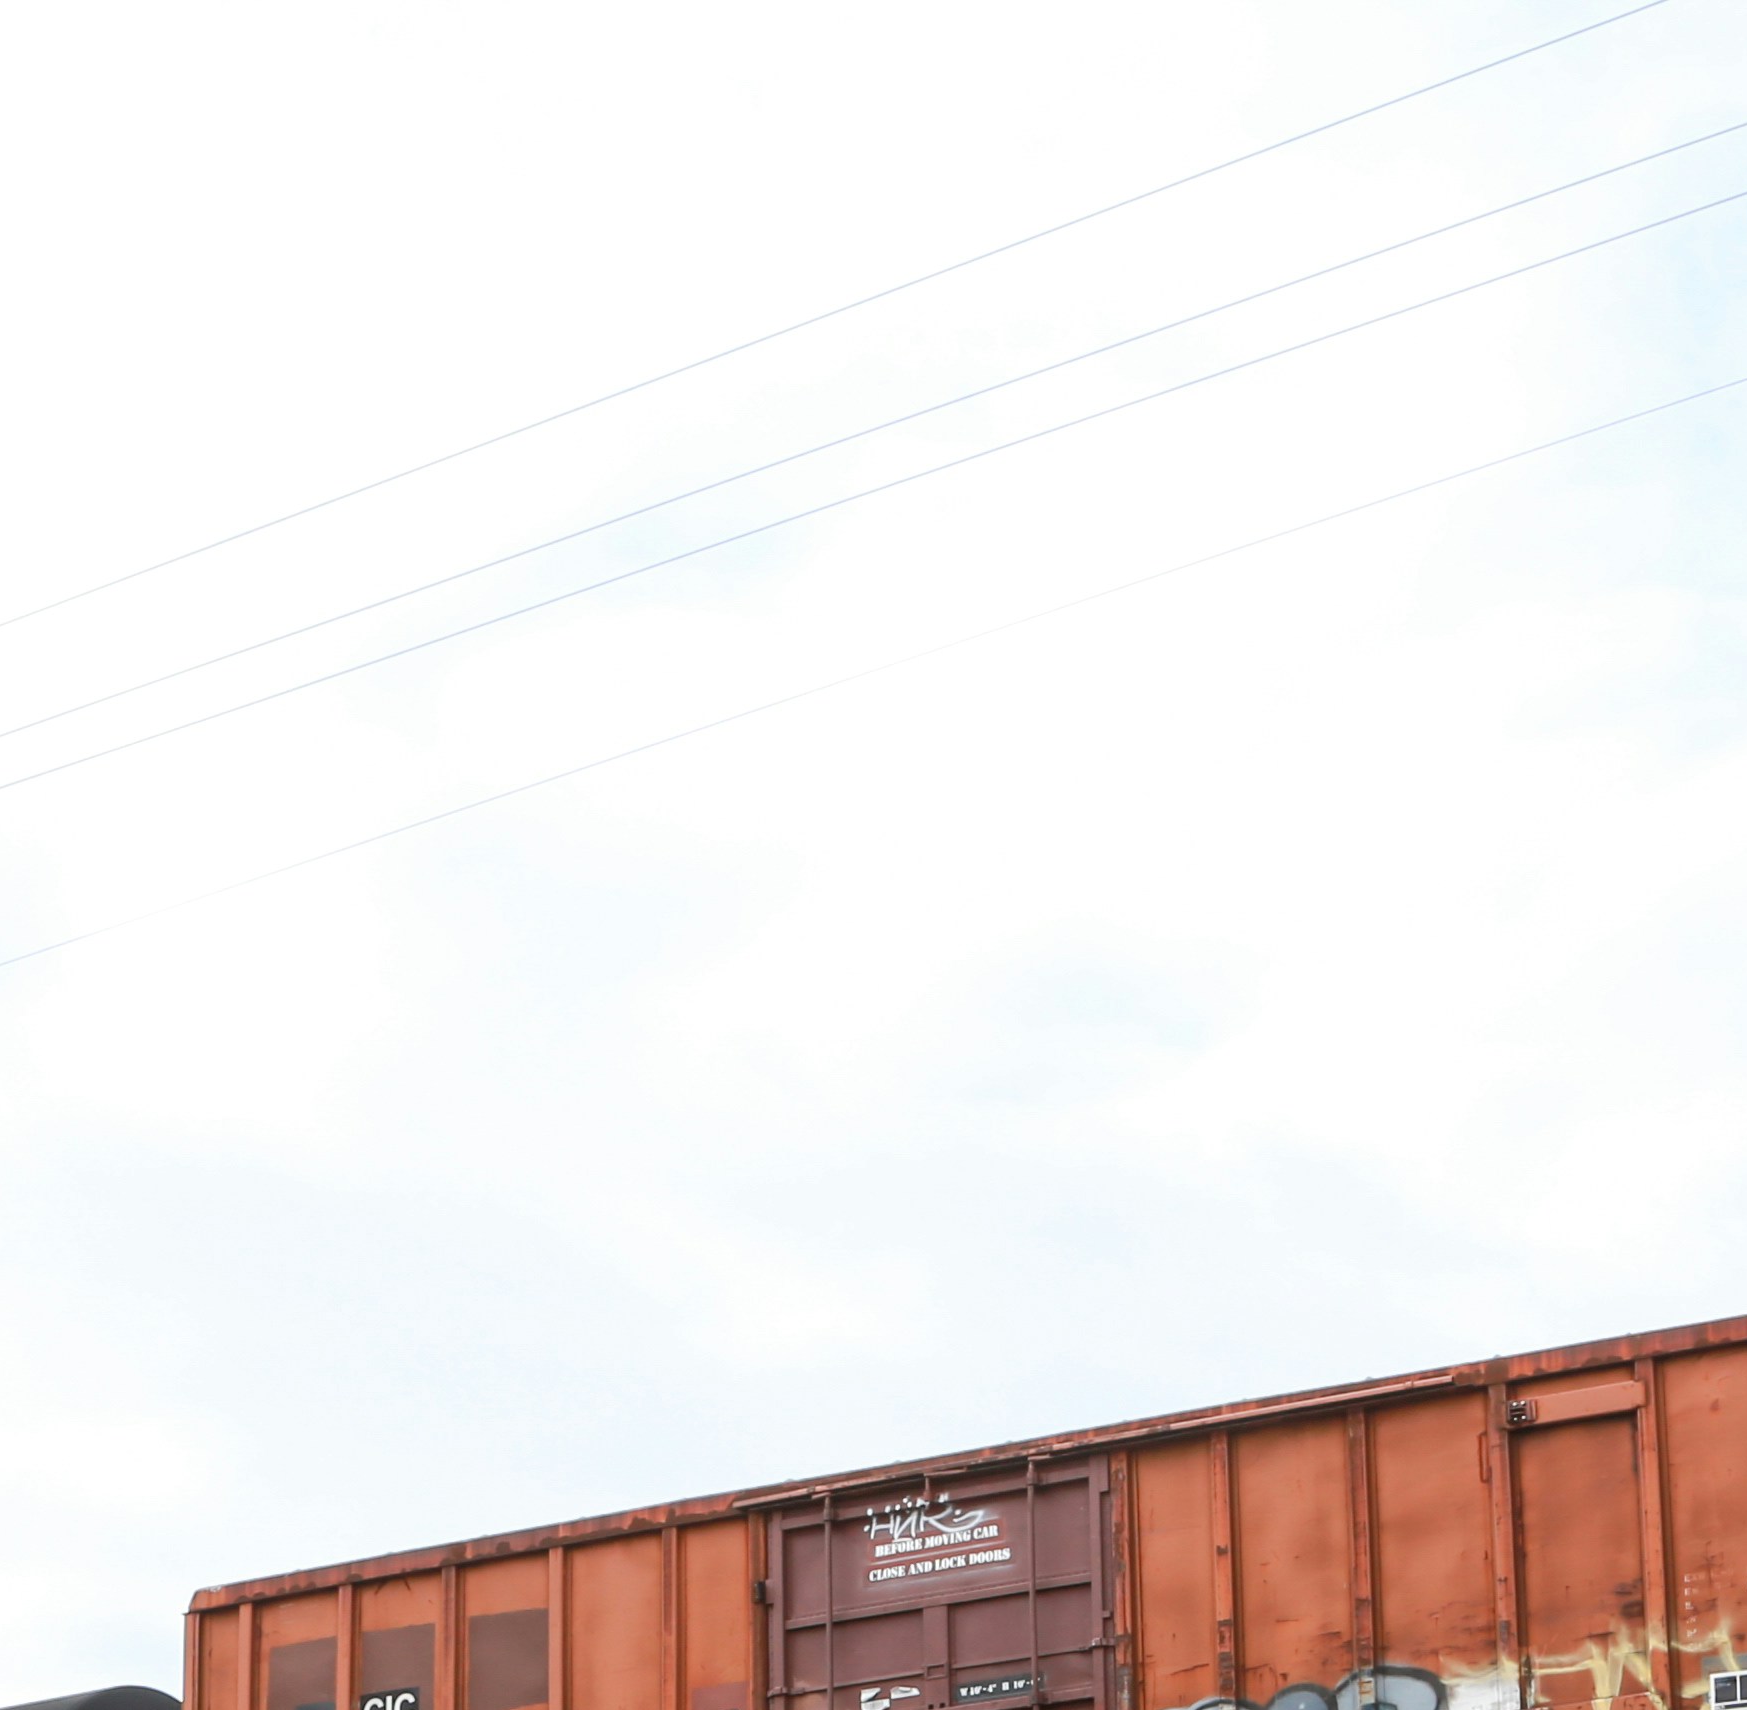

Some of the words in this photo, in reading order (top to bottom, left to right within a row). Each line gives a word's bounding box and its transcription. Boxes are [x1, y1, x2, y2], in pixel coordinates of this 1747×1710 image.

[874, 1537, 923, 1558] BEFORE
[924, 1530, 972, 1550] MOVING
[973, 1524, 999, 1540] CAR
[868, 1565, 906, 1583] CLOSE
[907, 1561, 933, 1576] AND
[934, 1555, 967, 1571] LOCK
[969, 1548, 1011, 1566] DOORS
